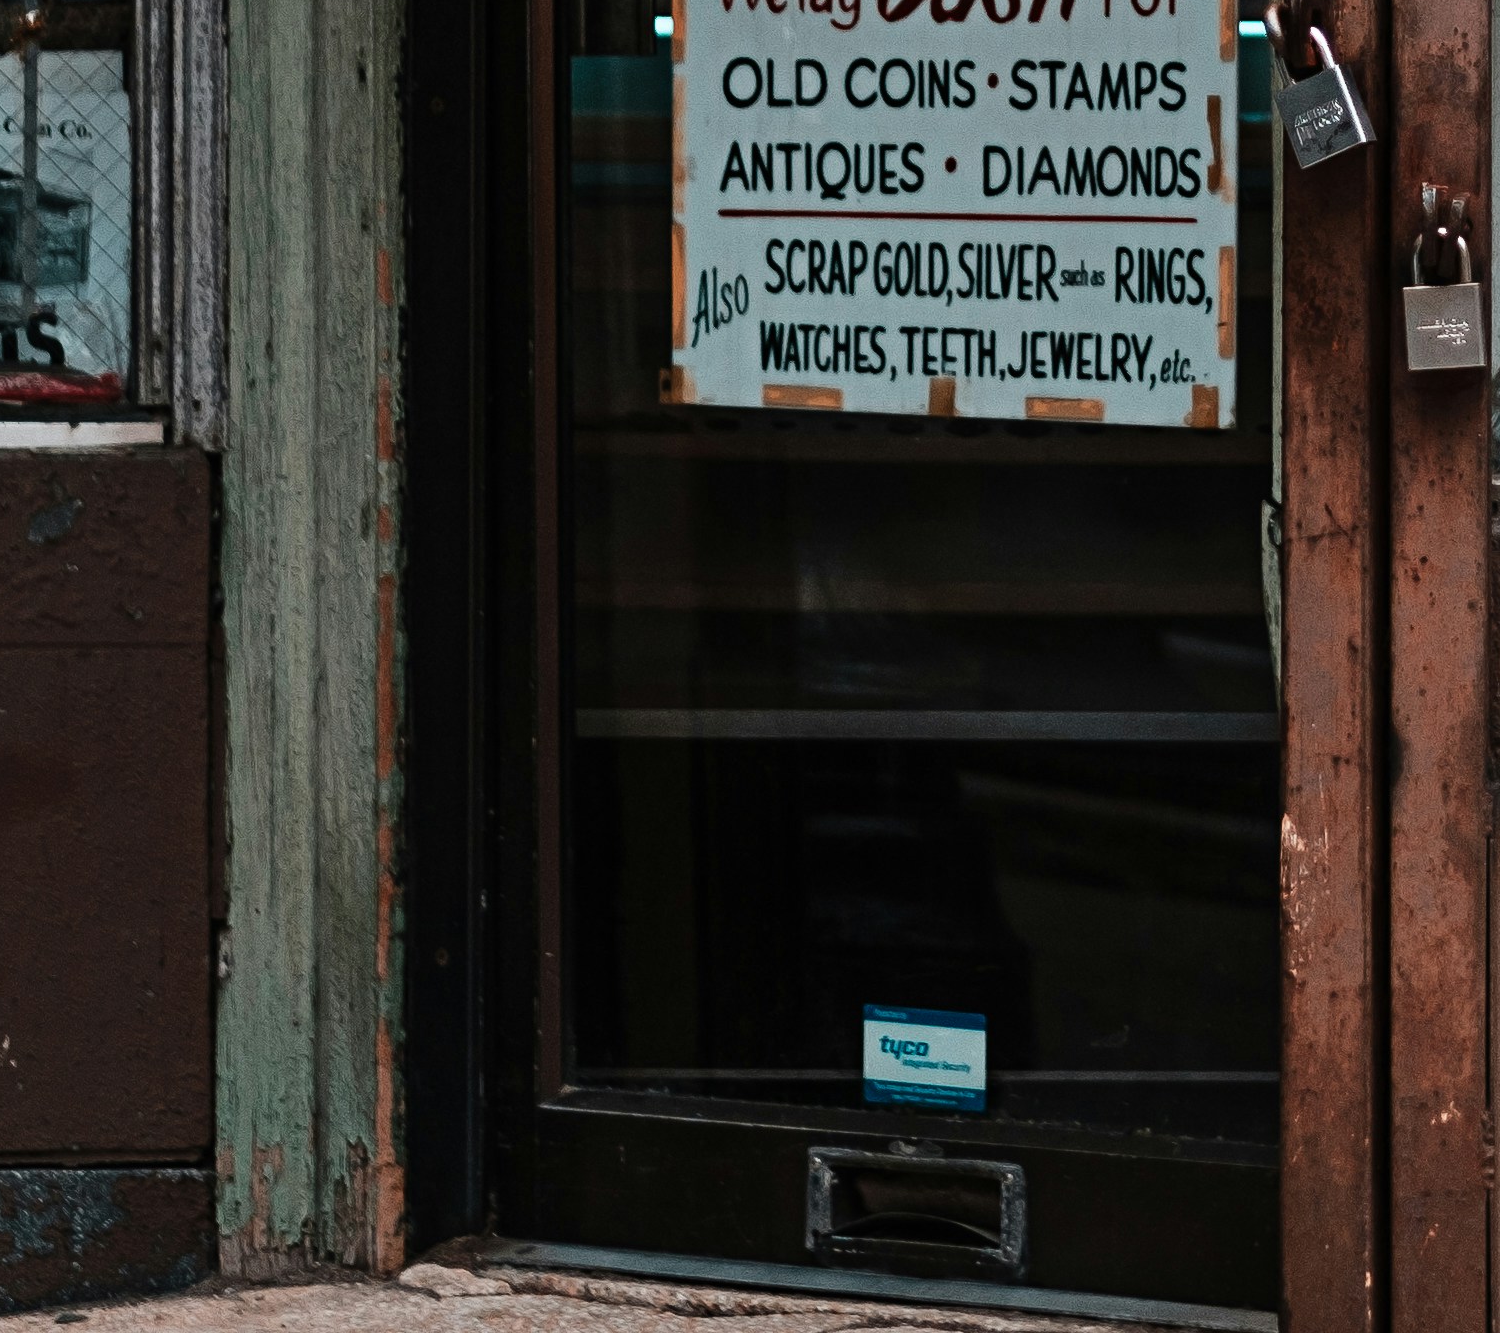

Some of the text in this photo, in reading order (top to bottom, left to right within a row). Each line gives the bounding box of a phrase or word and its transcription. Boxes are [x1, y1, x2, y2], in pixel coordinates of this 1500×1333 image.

[721, 57, 1188, 112] OLD COINS STAMPS
[719, 141, 1202, 201] ANTIQUES DIAMONDS
[691, 266, 750, 348] Also
[764, 238, 868, 297] SCRAP
[956, 241, 1060, 302] SILVER
[1060, 261, 1089, 288] such
[1090, 271, 1106, 287] as
[1114, 245, 1214, 314] RINGS,
[759, 320, 898, 381] WATCHES,
[899, 327, 1006, 381] TEETH,
[1006, 331, 1158, 391] JEWELRY,
[879, 1035, 930, 1061] tyco
